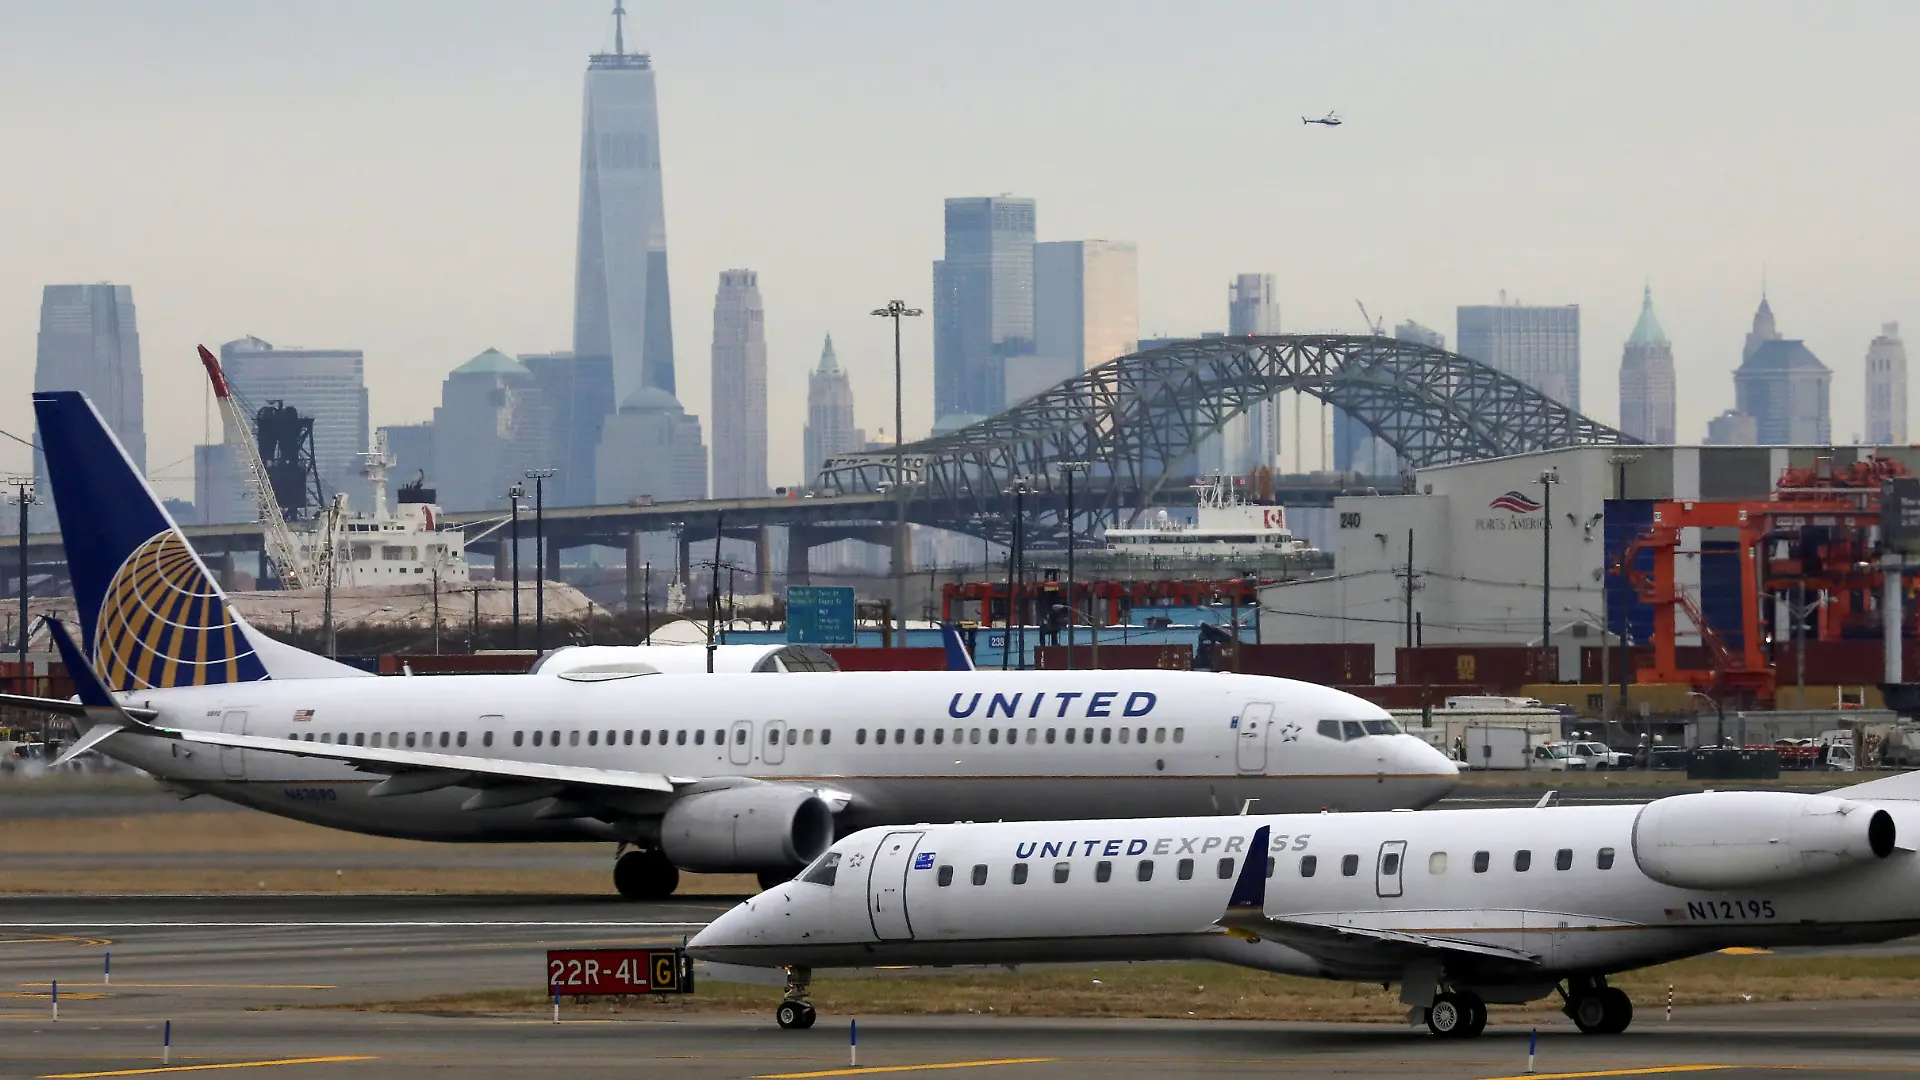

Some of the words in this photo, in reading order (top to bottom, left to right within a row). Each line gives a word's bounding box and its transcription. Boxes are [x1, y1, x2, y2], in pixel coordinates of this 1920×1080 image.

[1340, 512, 1361, 529] 240
[1475, 518, 1505, 531] PORTS
[948, 692, 1157, 719] UNITED
[1152, 834, 1311, 855] EXPRSS
[1687, 900, 1776, 920] N12195
[550, 958, 647, 985] 22R-4L
[656, 958, 672, 985] G
